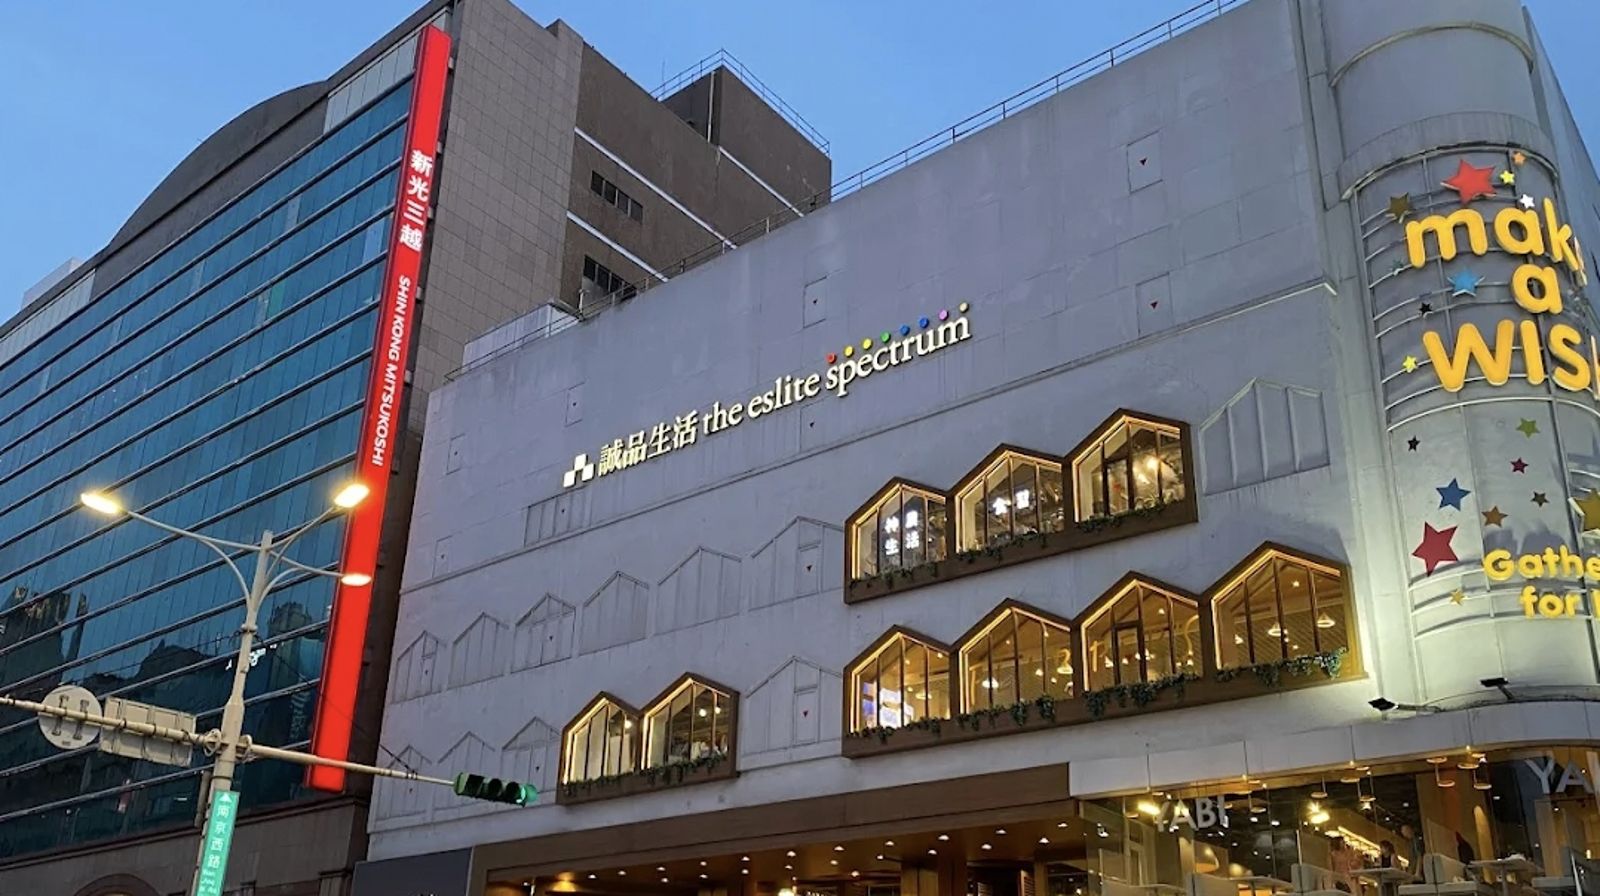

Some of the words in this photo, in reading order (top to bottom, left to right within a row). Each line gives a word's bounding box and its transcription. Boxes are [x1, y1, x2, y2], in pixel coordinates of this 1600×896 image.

[400, 149, 433, 253] 新光三越
[391, 275, 411, 315] SHIN
[1511, 263, 1563, 315] a
[388, 316, 405, 361] KONG
[702, 401, 742, 435] the
[748, 373, 821, 419] eslite
[825, 314, 972, 397] spectrum
[372, 363, 398, 466] MITSUKOSHI
[598, 409, 699, 476] 誠品生活
[1521, 585, 1580, 619] for
[208, 804, 231, 869] 南京西路
